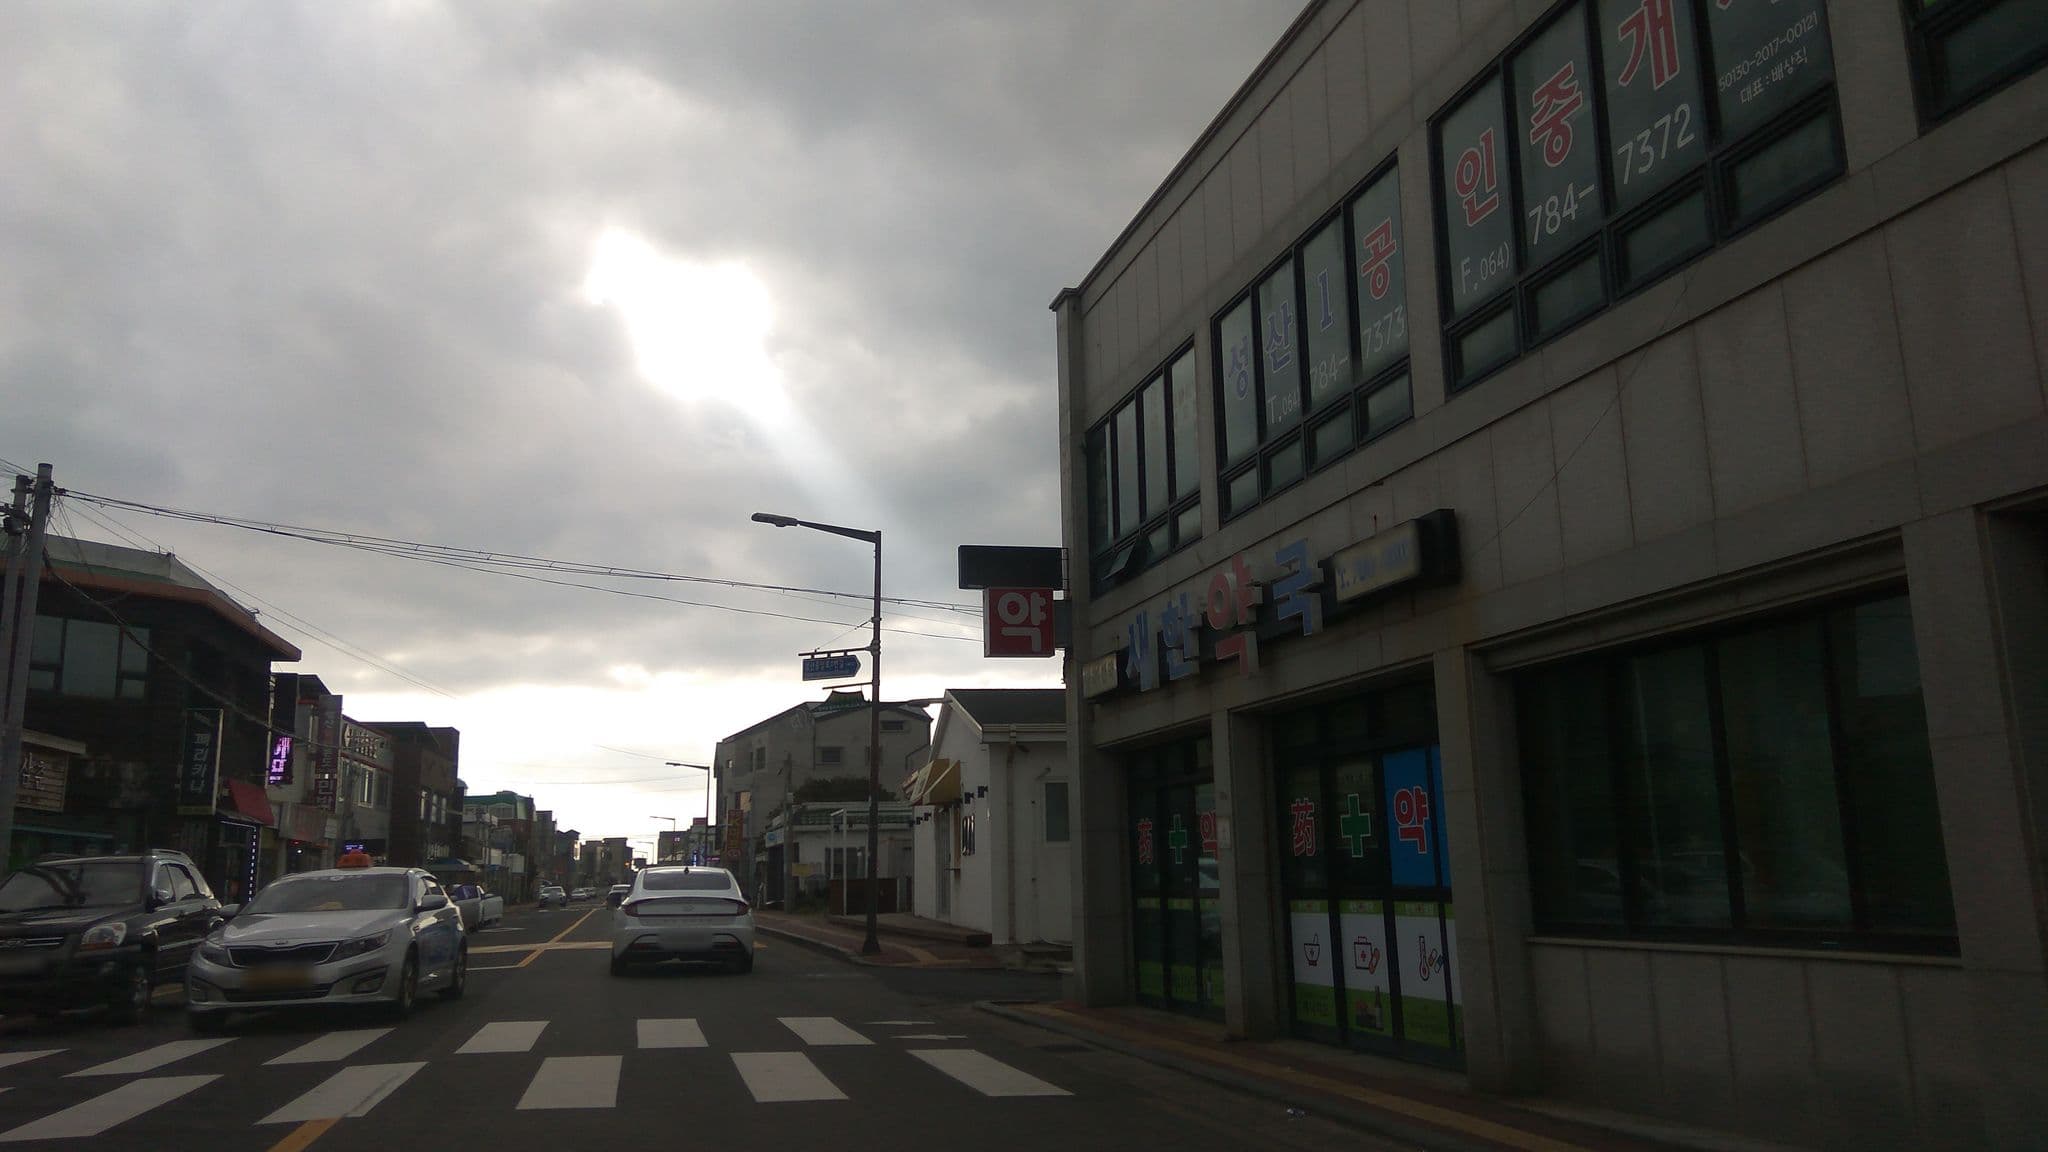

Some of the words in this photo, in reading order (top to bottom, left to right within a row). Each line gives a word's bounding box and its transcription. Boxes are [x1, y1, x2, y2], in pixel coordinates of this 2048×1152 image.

[1718, 10, 1818, 92] 50130-2017-00121
[996, 590, 1048, 653] 약
[1126, 537, 1312, 692] 새한약국
[1393, 785, 1430, 855] 약
